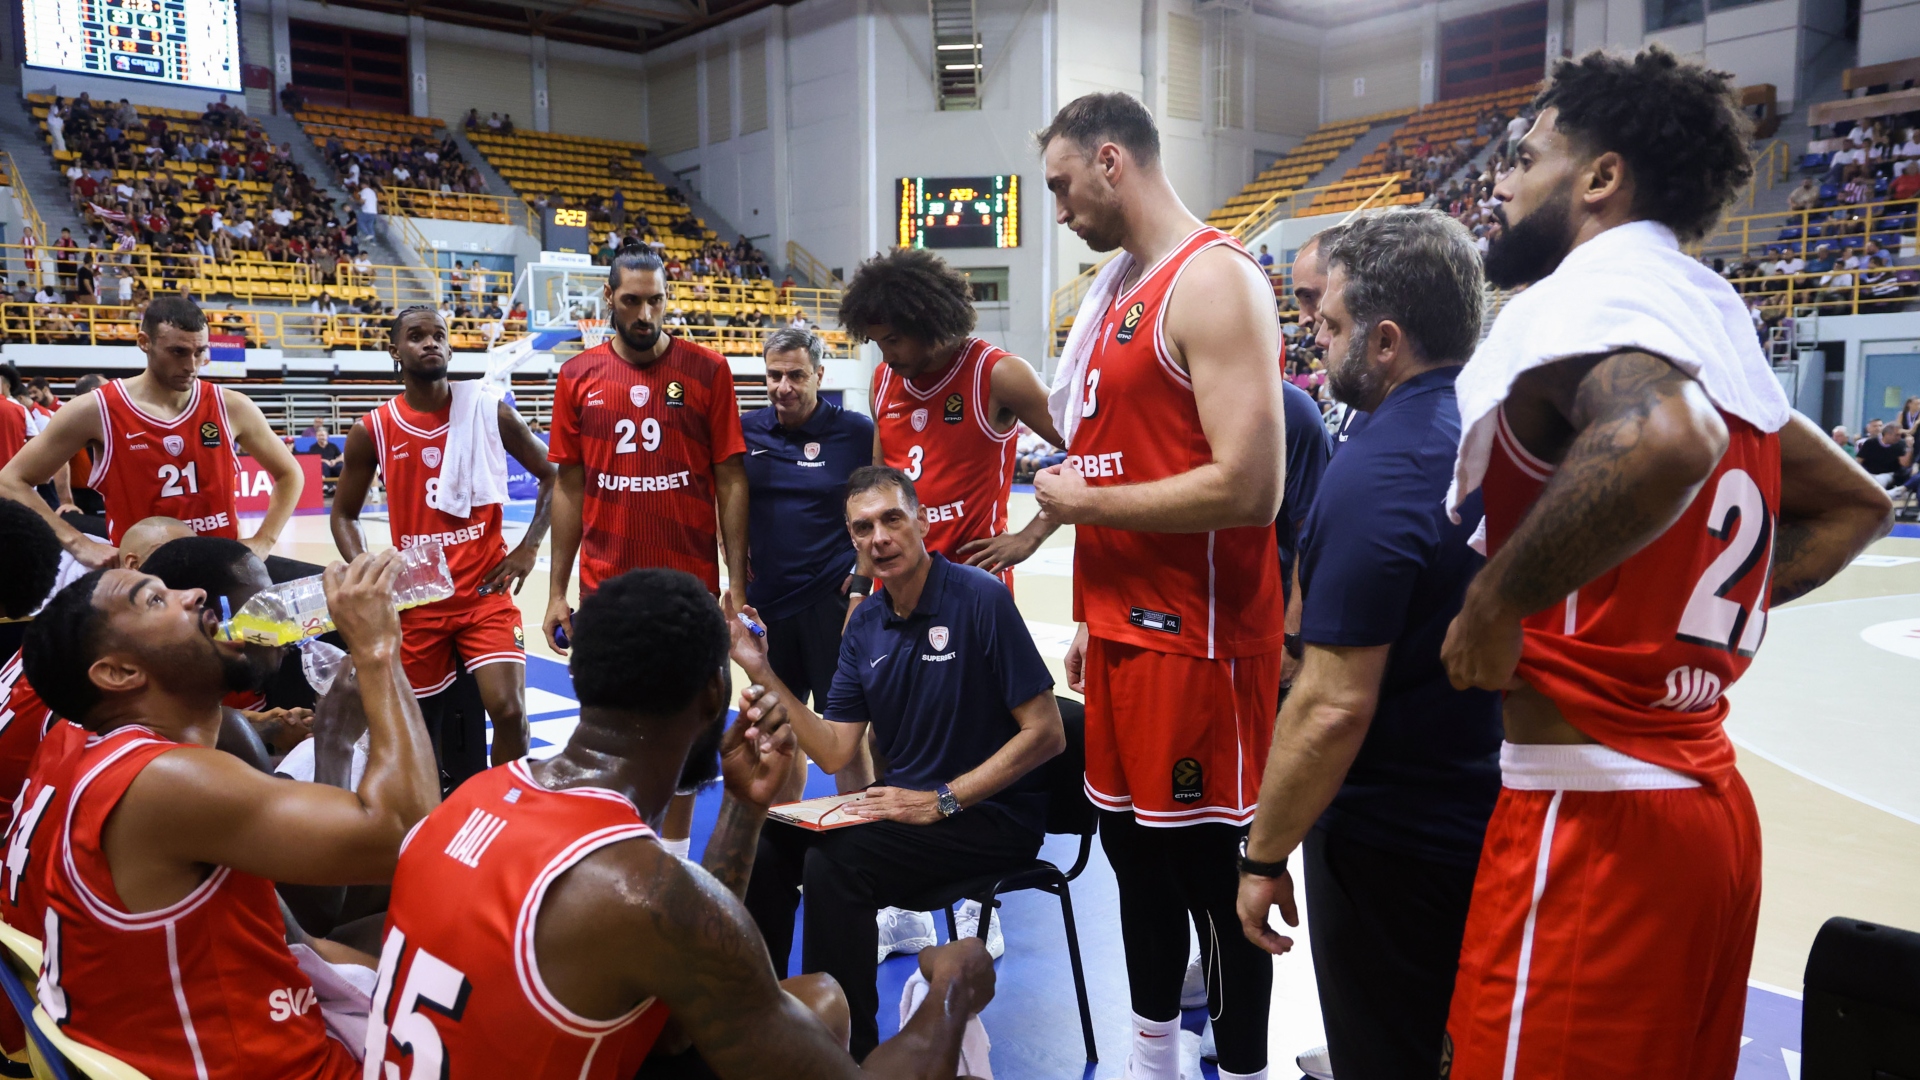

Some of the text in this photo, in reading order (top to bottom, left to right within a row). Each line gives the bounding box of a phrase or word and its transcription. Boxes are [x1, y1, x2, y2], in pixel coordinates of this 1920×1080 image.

[614, 416, 663, 455] 29
[157, 460, 199, 498] 21
[597, 470, 690, 492] SUPERBET
[796, 460, 826, 468] SUPERBET
[903, 444, 925, 482] 3
[921, 651, 956, 662] SUPERBET
[443, 807, 508, 869] HALL
